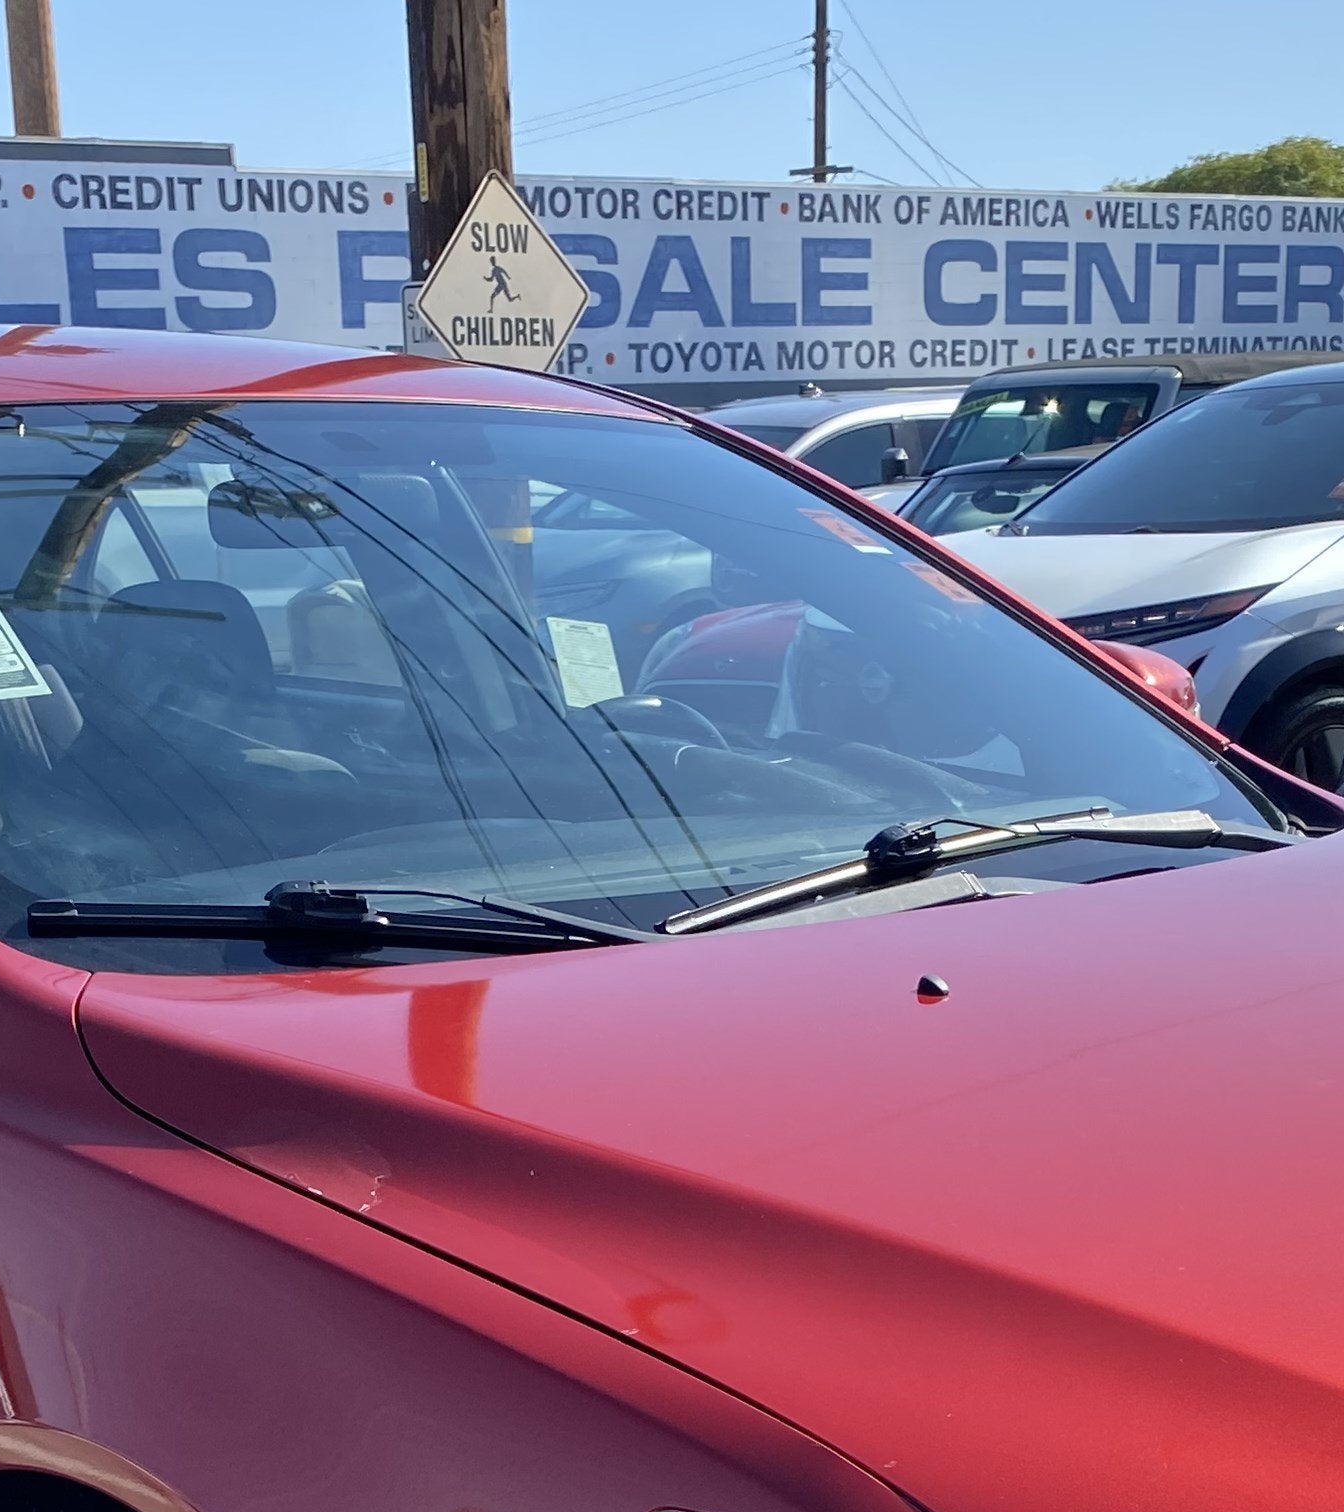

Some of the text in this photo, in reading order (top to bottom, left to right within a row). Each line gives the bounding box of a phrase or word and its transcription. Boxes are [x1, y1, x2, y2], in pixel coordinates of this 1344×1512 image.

[51, 173, 202, 212] CREDIT
[218, 177, 370, 215] UNIONS
[516, 185, 640, 219] MOTOR
[652, 188, 771, 222] CREDIT
[798, 193, 882, 225] BANK
[894, 195, 931, 225] OF
[939, 197, 1070, 228] AMERICA
[1096, 200, 1181, 231] WELLS
[1189, 203, 1272, 232] FARGO
[470, 220, 529, 254] SLOW
[411, 326, 440, 344] LIM
[451, 315, 555, 347] CHILDREN
[628, 341, 766, 374] TOYOTA
[776, 339, 896, 372] MOTOR
[908, 338, 1018, 369] CREDIT
[1047, 337, 1134, 362] LEASE
[1144, 334, 1344, 356] TERMINATIONS
